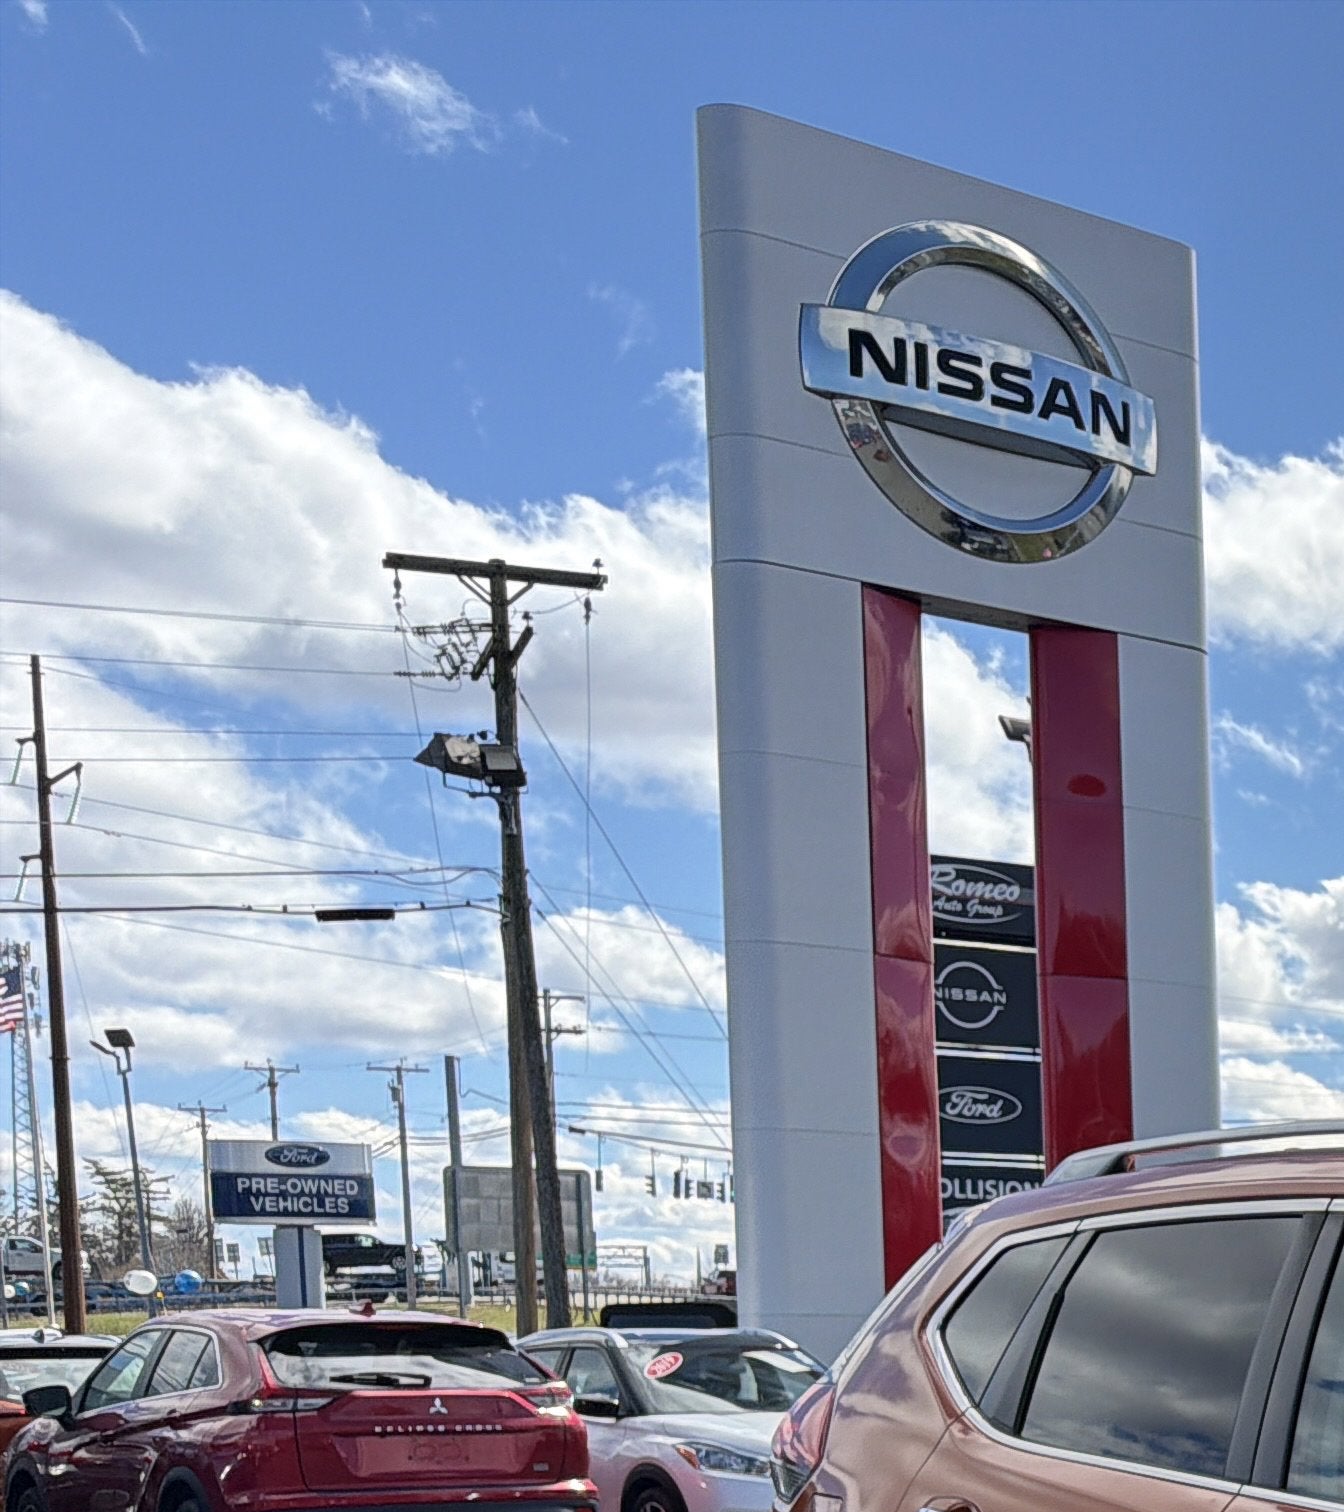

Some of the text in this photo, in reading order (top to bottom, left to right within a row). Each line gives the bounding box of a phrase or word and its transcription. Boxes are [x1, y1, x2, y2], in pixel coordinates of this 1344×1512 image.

[847, 328, 1131, 448] NISSAN
[931, 866, 1020, 902] Romeo
[933, 896, 1003, 919] Auto Group
[945, 1090, 1003, 1118] Ford
[279, 1147, 318, 1164] Ford
[236, 1177, 359, 1196] PRE-OWNED
[250, 1196, 350, 1214] VEHICLES
